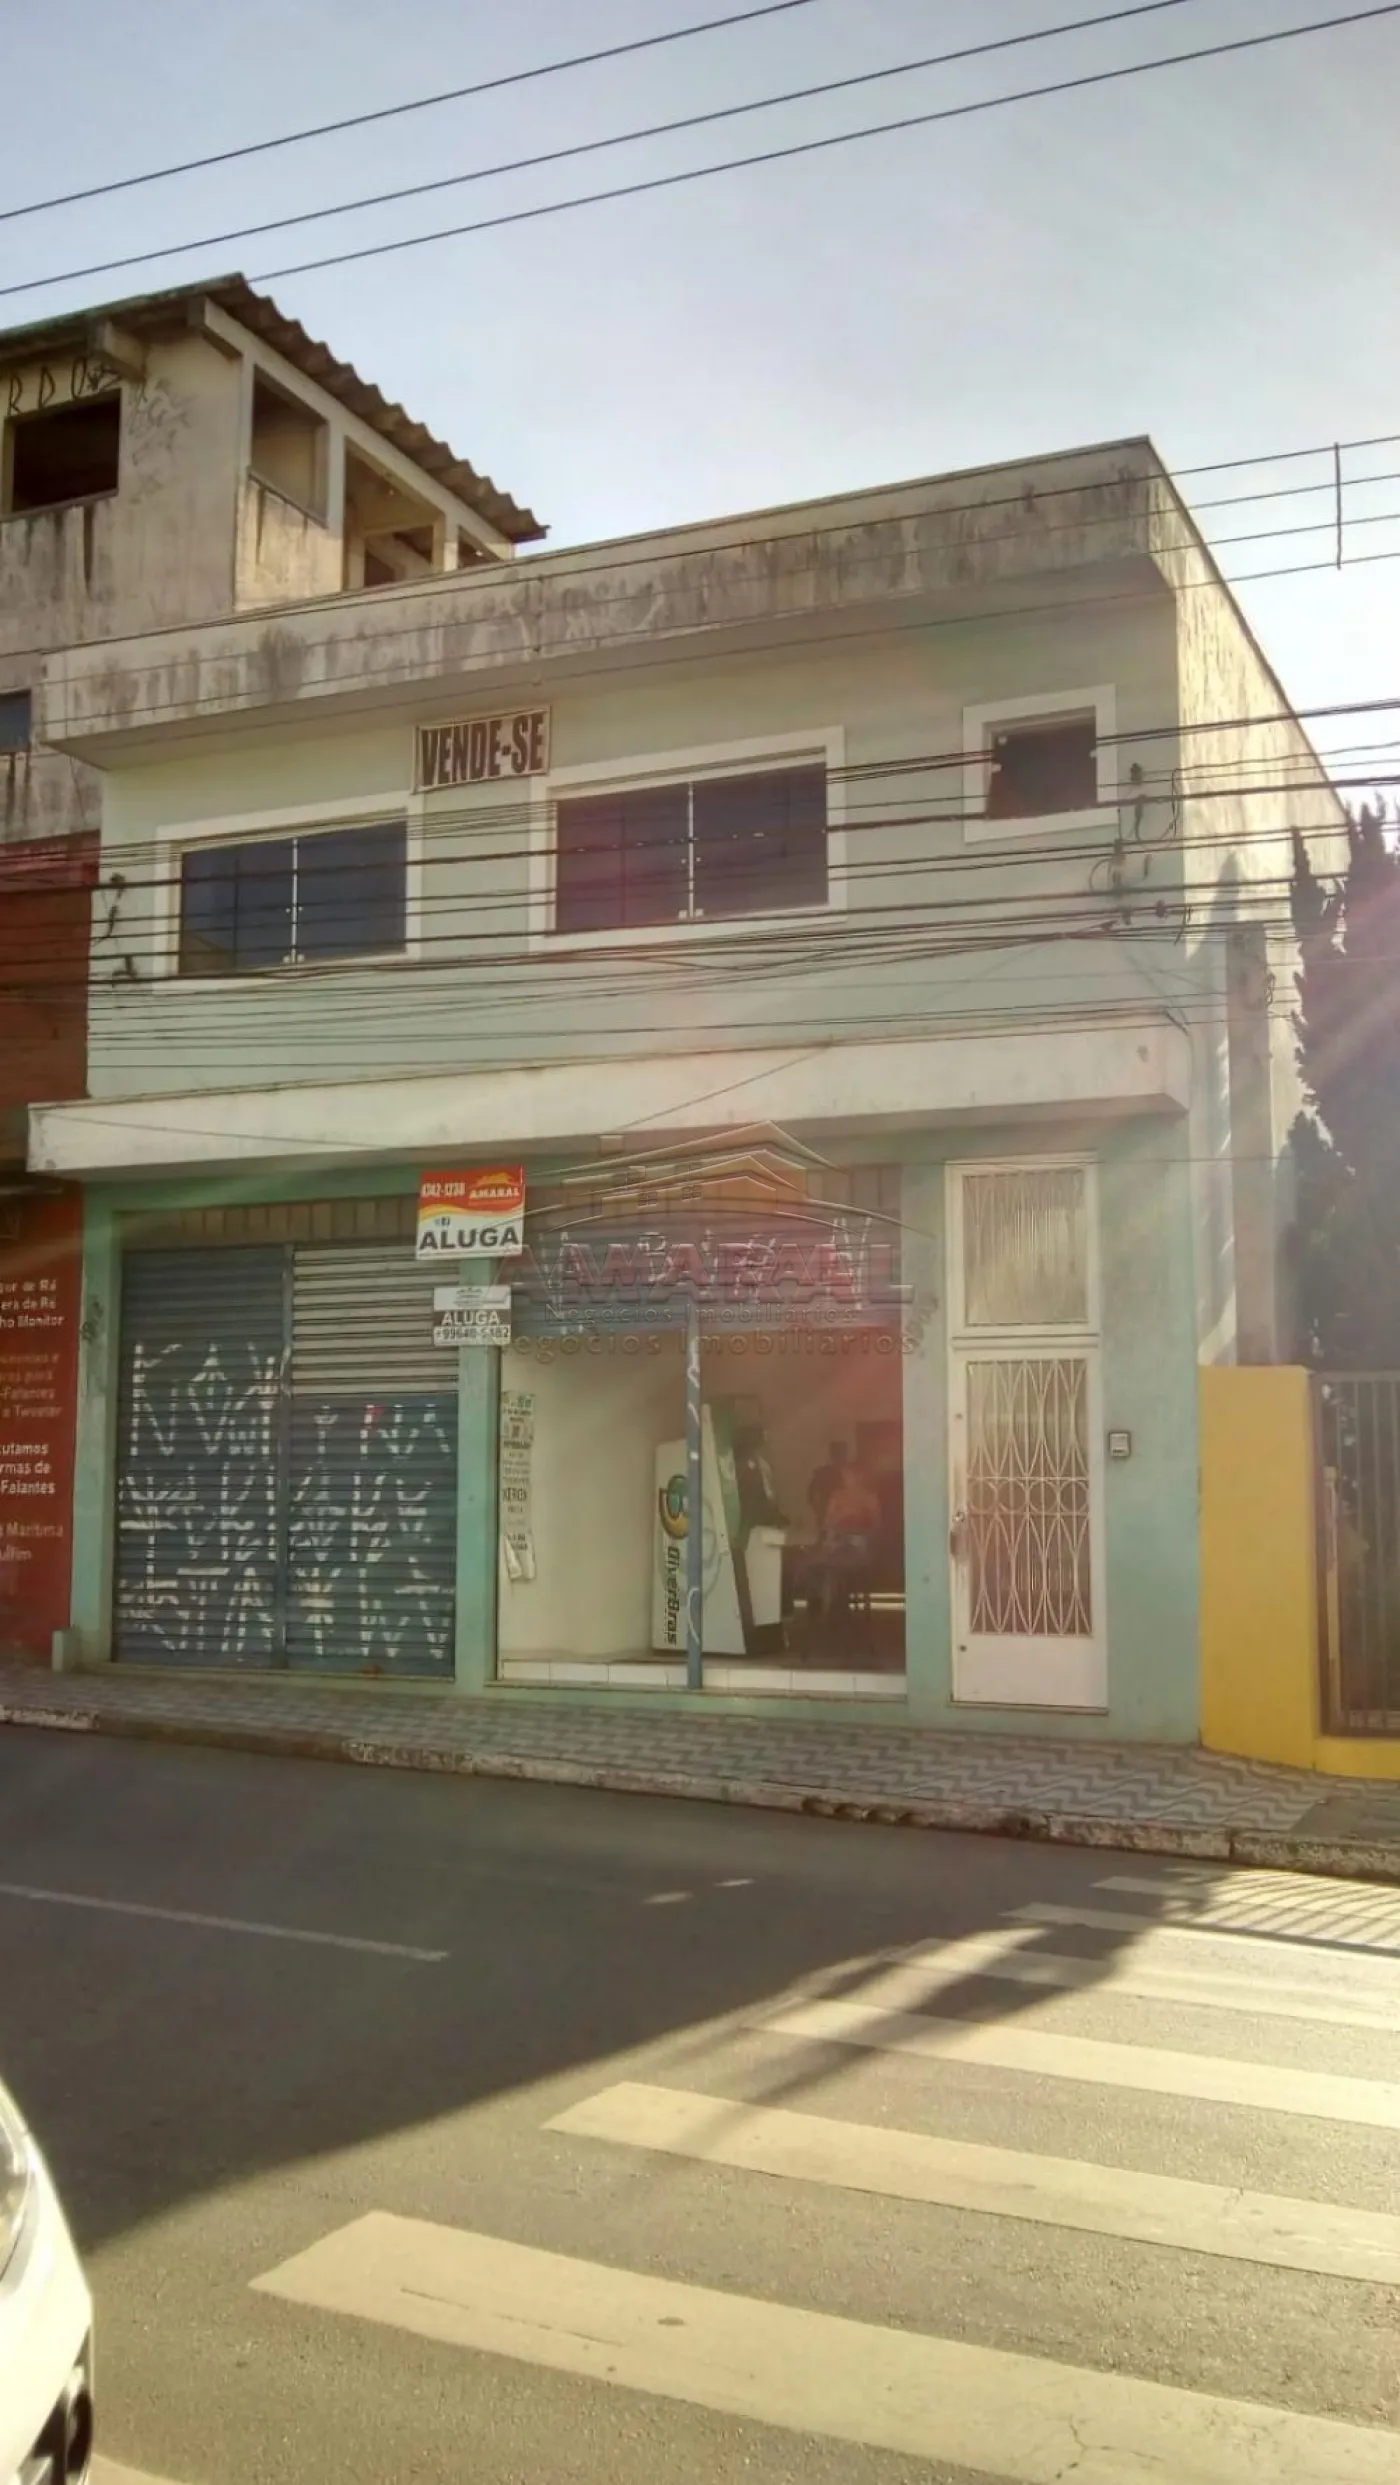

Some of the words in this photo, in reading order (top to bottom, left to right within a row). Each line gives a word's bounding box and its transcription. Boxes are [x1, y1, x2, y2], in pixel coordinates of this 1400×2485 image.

[421, 712, 544, 786] VENDE-SE
[420, 1226, 519, 1251] ALUGA
[441, 1310, 499, 1327] ALUGA
[34, 1460, 51, 1475] de
